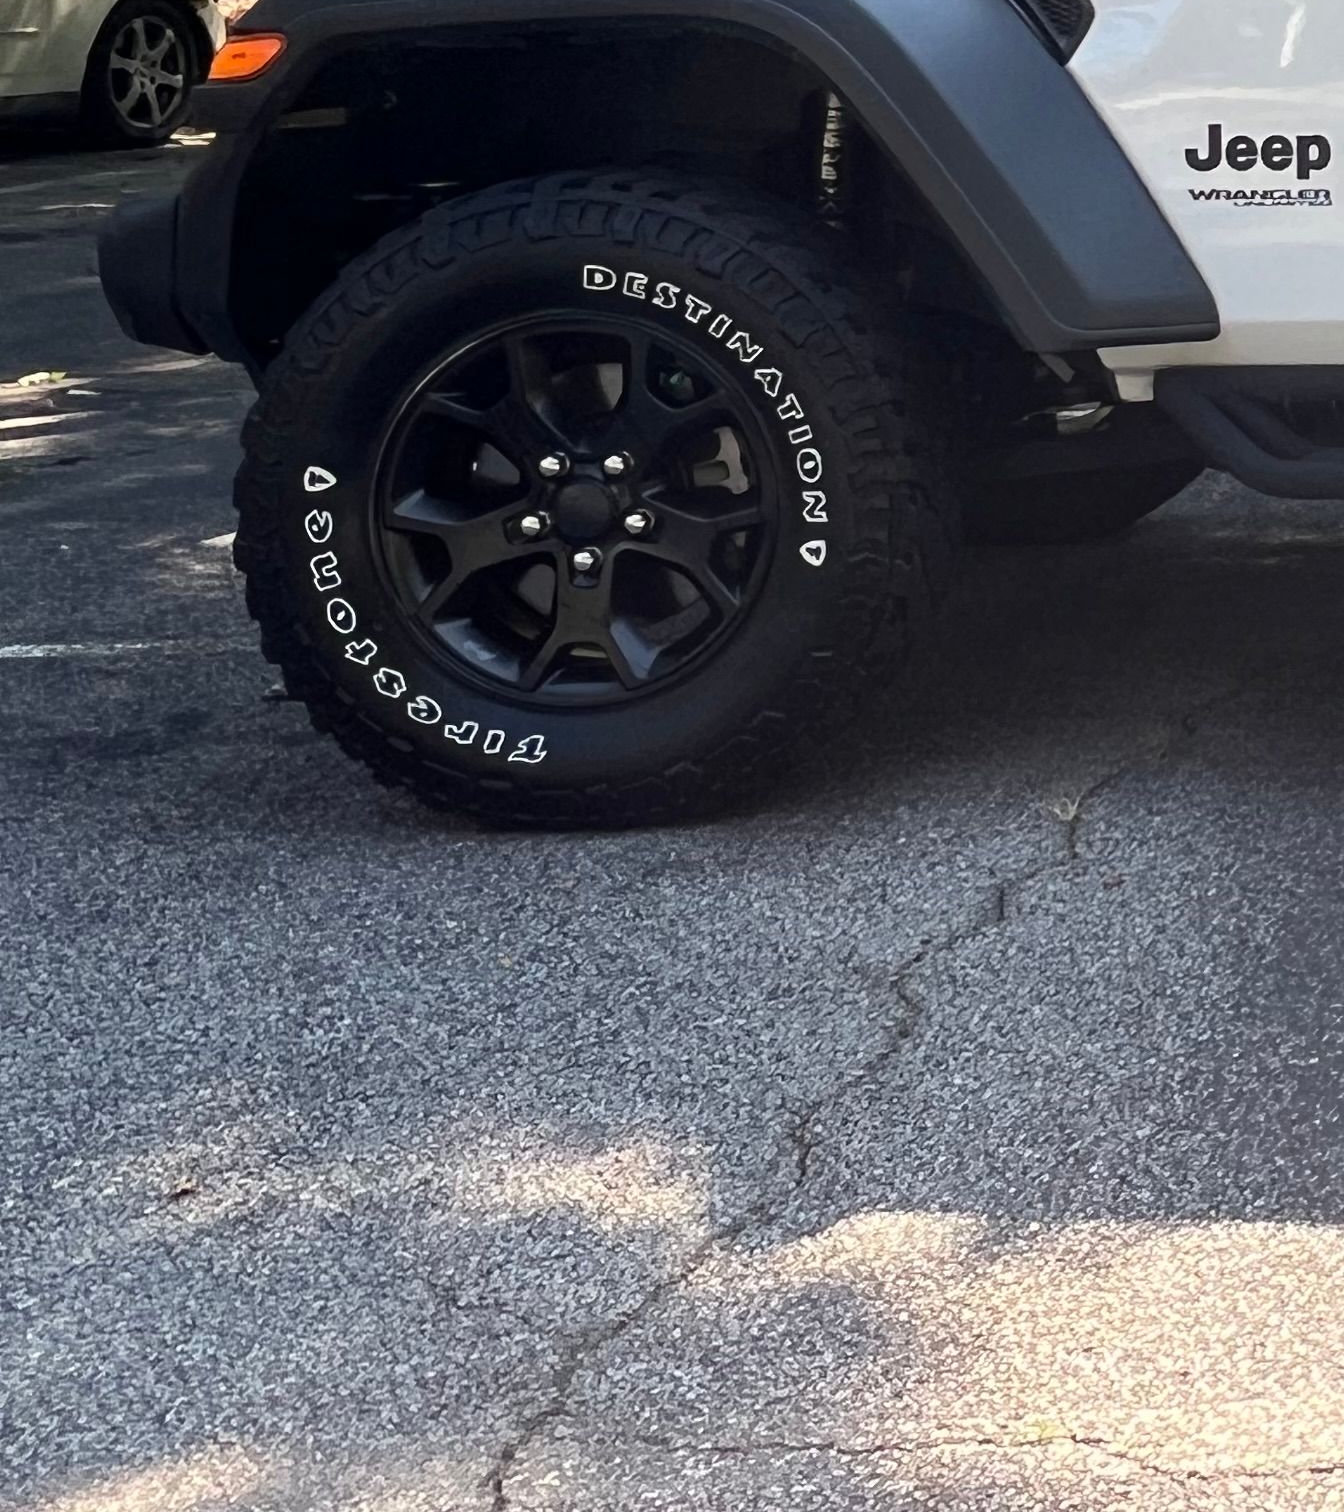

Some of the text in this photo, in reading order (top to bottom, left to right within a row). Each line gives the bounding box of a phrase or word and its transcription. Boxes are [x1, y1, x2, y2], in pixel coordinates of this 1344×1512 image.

[1185, 124, 1332, 180] Jeep
[582, 264, 829, 523] DESTINATION
[304, 509, 548, 764] Firestone
